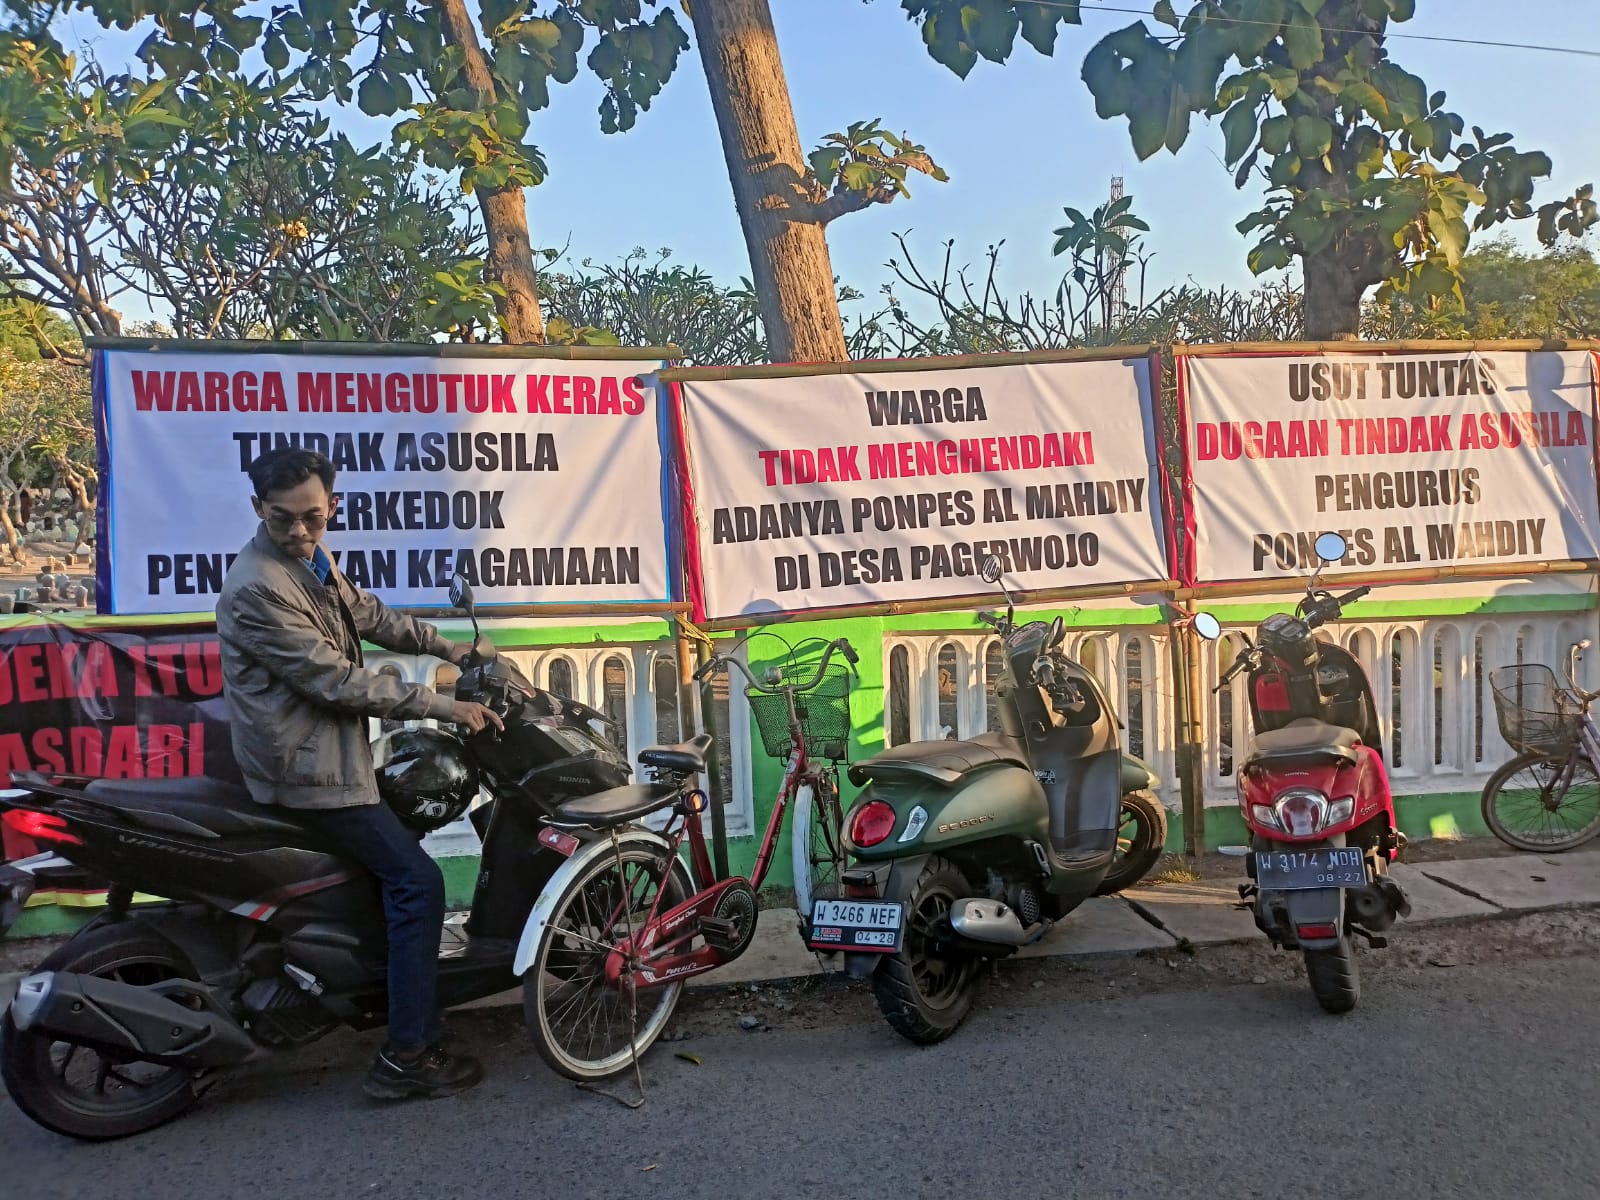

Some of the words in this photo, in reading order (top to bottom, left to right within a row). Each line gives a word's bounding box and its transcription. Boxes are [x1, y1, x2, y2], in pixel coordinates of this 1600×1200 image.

[131, 370, 288, 412] WARGA
[297, 372, 521, 414] MENGUTUK
[526, 374, 645, 416] KERAS
[1289, 362, 1369, 402] USUT
[1377, 358, 1496, 398] TUNTAS
[865, 386, 987, 427] WARGA
[394, 432, 559, 473] ASUSILA
[759, 446, 862, 486] TIDAK
[868, 431, 1095, 480] MENGHENDAKI
[1196, 420, 1328, 461] DUGAAN
[1336, 414, 1453, 455] TINDAK
[1460, 411, 1587, 450] ASUSILA
[327, 490, 504, 531] ERKEDOK
[713, 498, 844, 544] ADANYA
[852, 489, 975, 533] PONPES
[982, 487, 1019, 522] AL
[1025, 478, 1145, 519] MAHDIY
[1315, 467, 1481, 512] PENGURUS
[775, 555, 812, 592] DI
[818, 543, 901, 587] DESA
[911, 532, 1099, 580] PAGERWOJO
[1253, 528, 1376, 571] PONES
[1384, 524, 1421, 563] AL
[1427, 518, 1546, 561] MAHDIY
[408, 547, 640, 588] KEAGAMAAN
[128, 641, 223, 697] ITU
[1261, 854, 1271, 869] W
[1280, 853, 1318, 868] 3174
[1329, 851, 1360, 866] NDH
[817, 904, 826, 921] W
[832, 905, 864, 923] 3466
[870, 907, 896, 925] NEF
